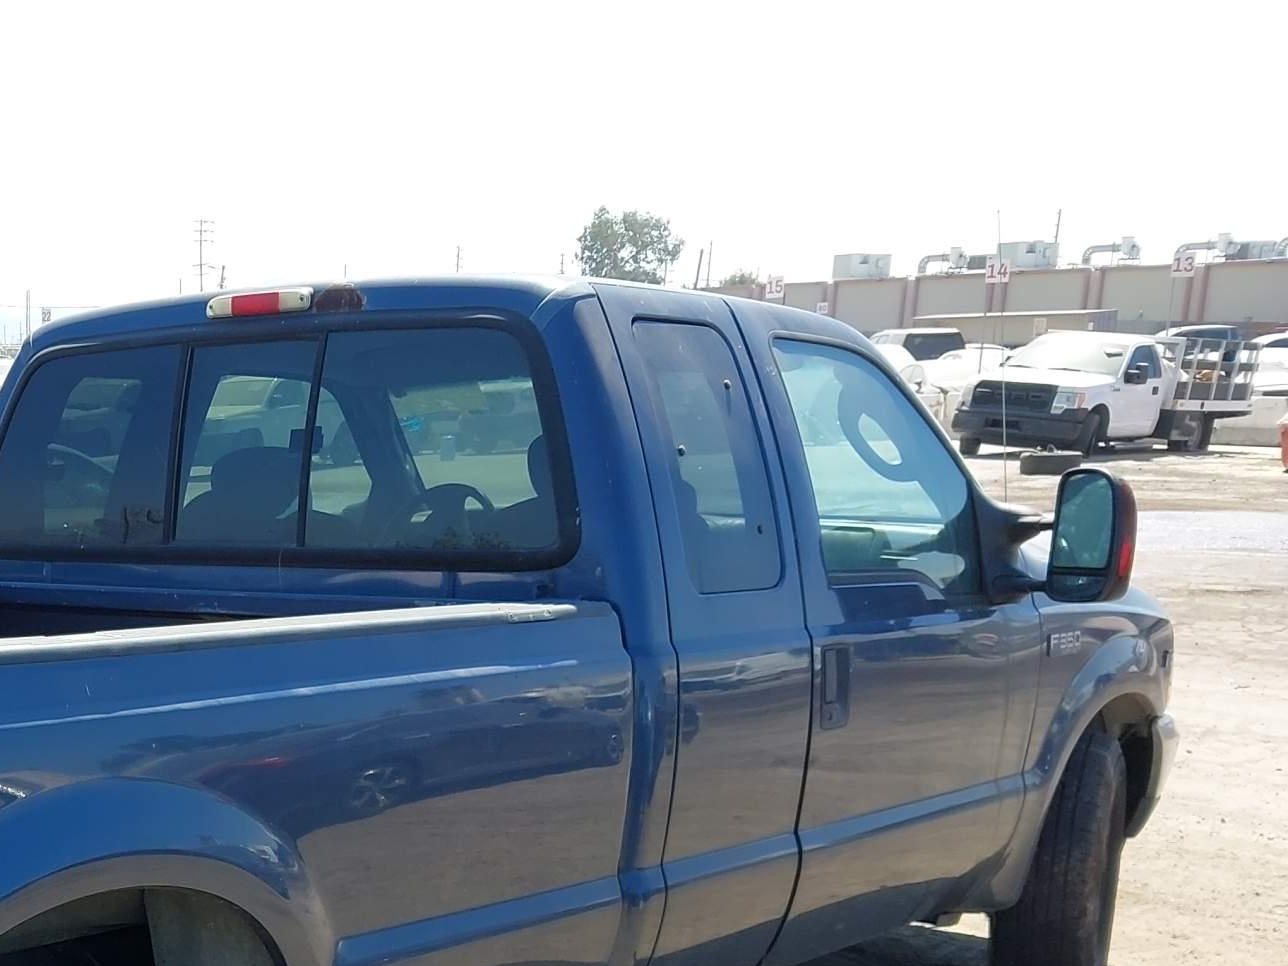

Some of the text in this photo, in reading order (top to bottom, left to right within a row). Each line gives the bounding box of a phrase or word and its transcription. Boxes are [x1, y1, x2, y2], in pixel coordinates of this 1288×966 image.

[986, 263, 1008, 279] 14
[1172, 256, 1194, 273] 13
[767, 279, 783, 295] 15
